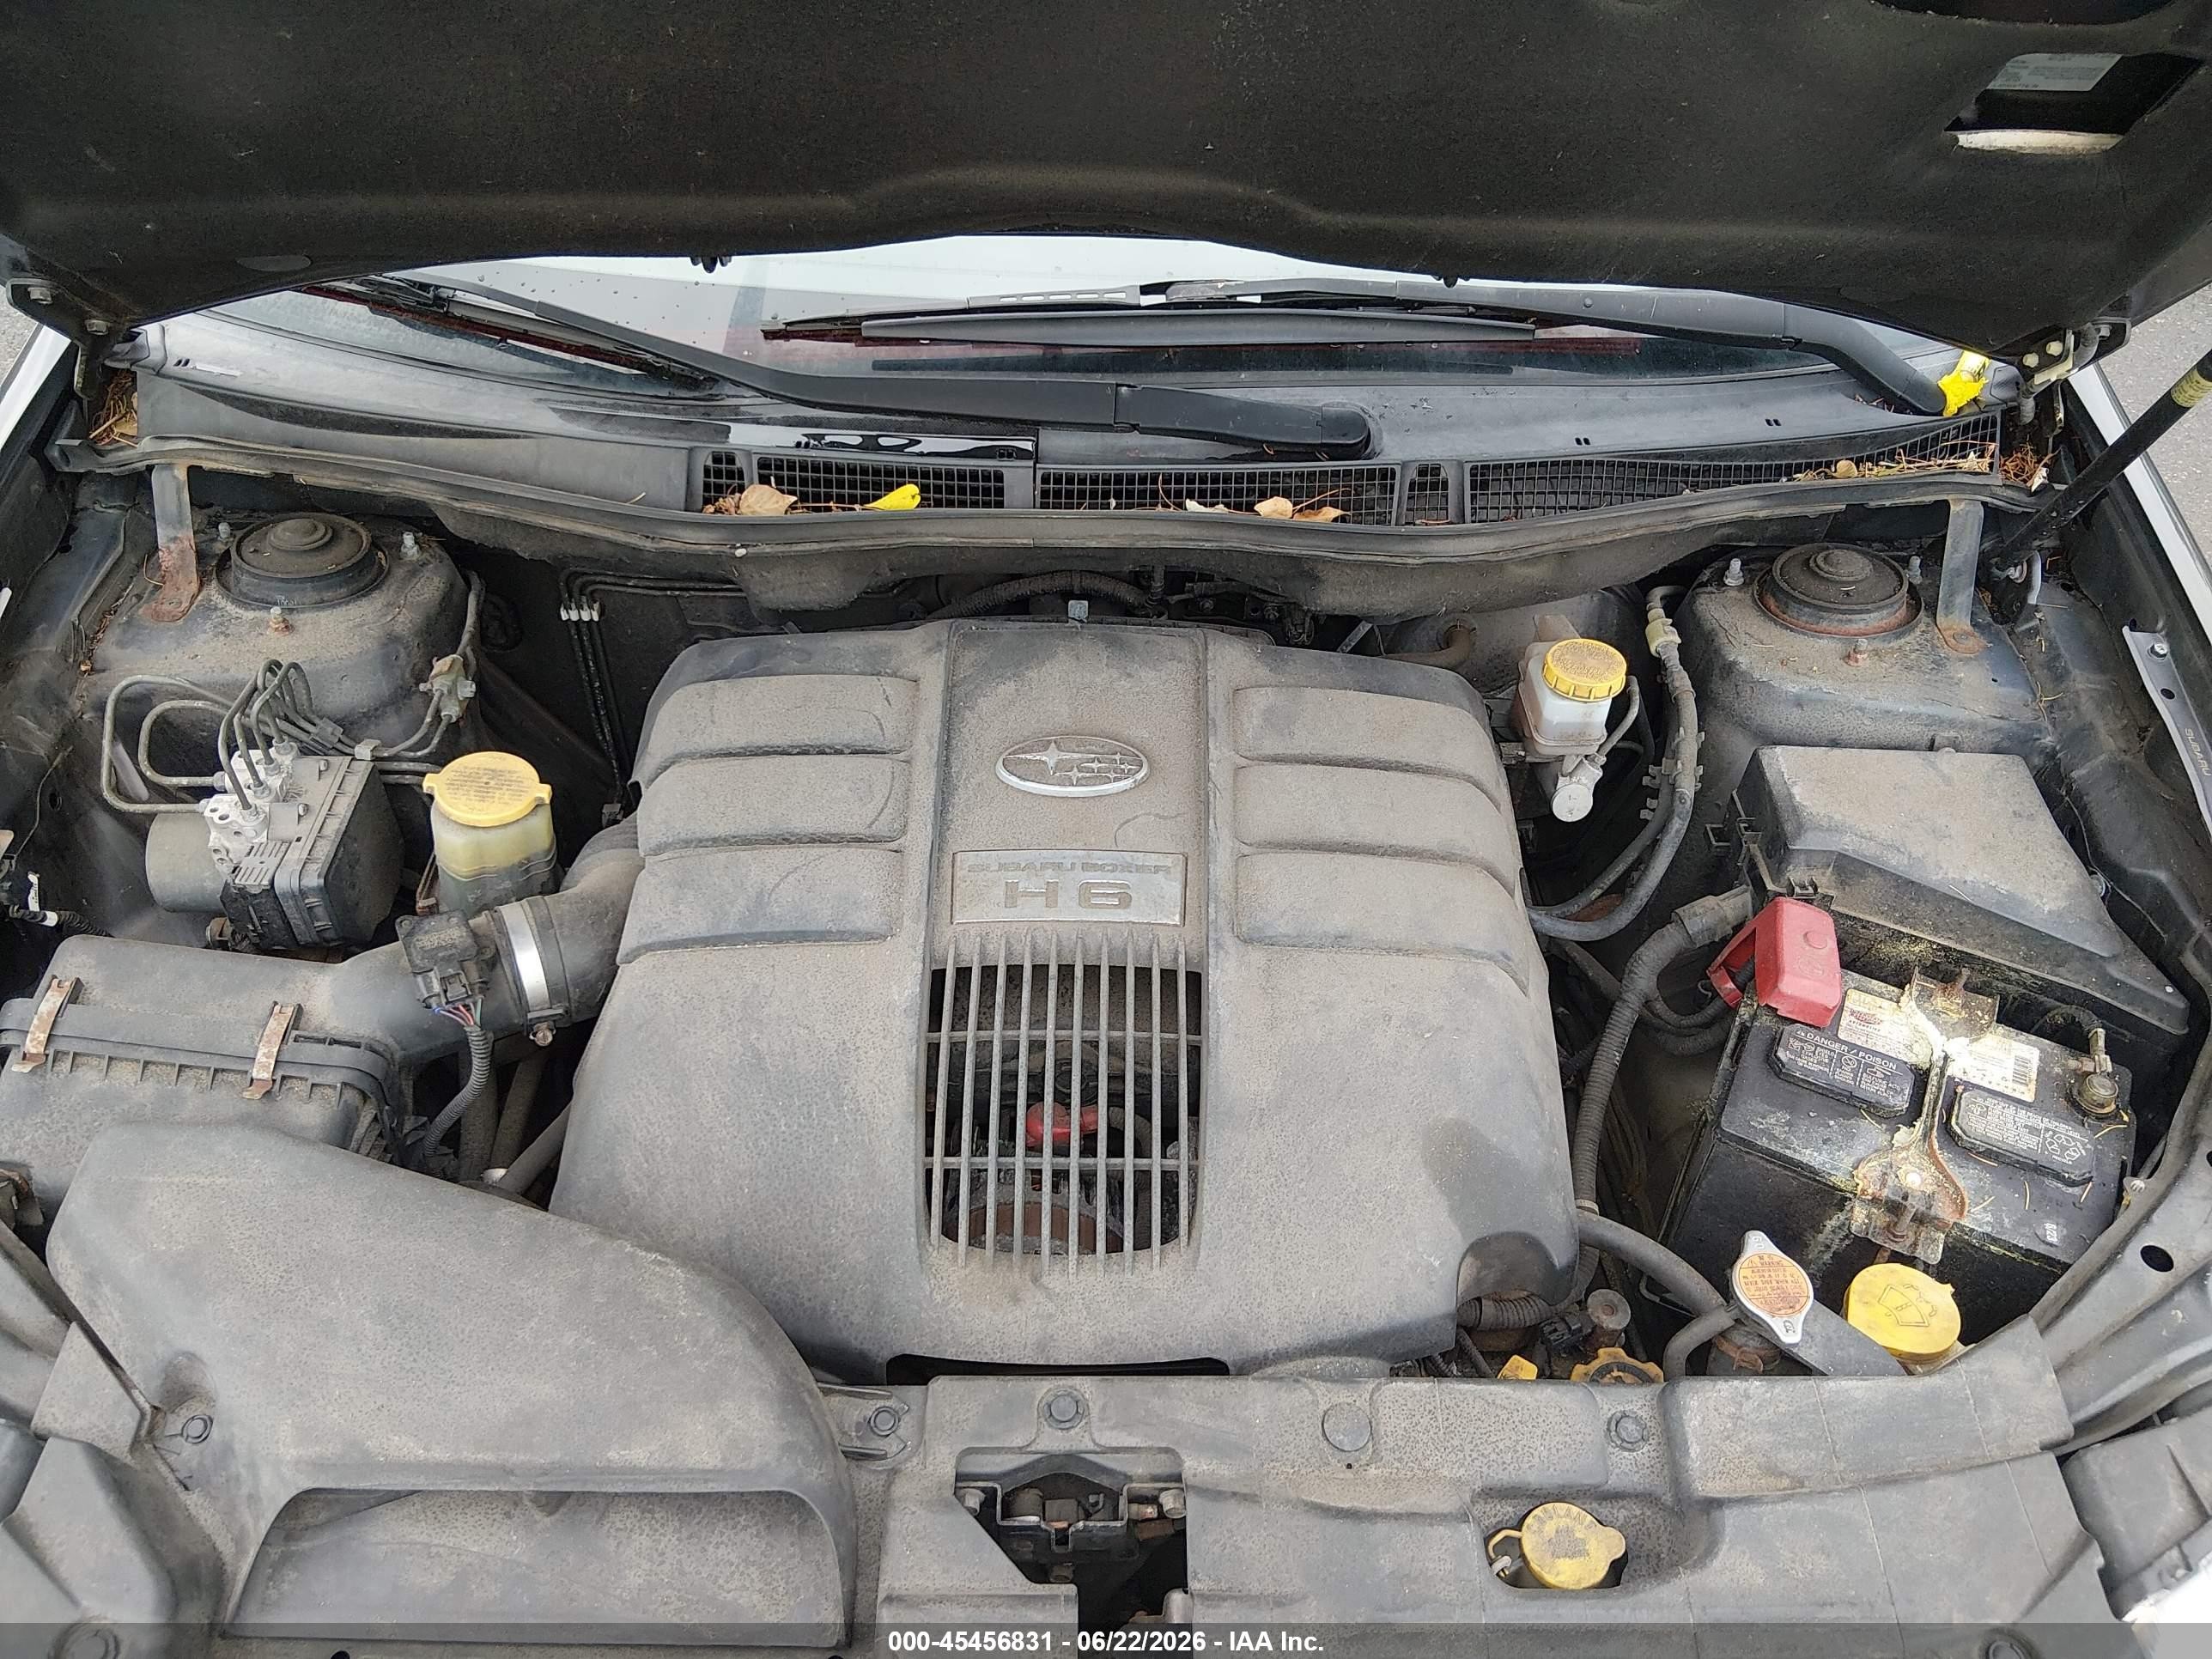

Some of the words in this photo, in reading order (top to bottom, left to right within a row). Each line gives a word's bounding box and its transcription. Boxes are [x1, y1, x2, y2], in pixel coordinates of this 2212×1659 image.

[2185, 727, 2212, 776] SUBARU
[968, 861, 1076, 873] SUBARU
[1081, 861, 1172, 874] BOXER
[1806, 1032, 1848, 1052] DANGER
[1857, 1051, 1897, 1070] POISON
